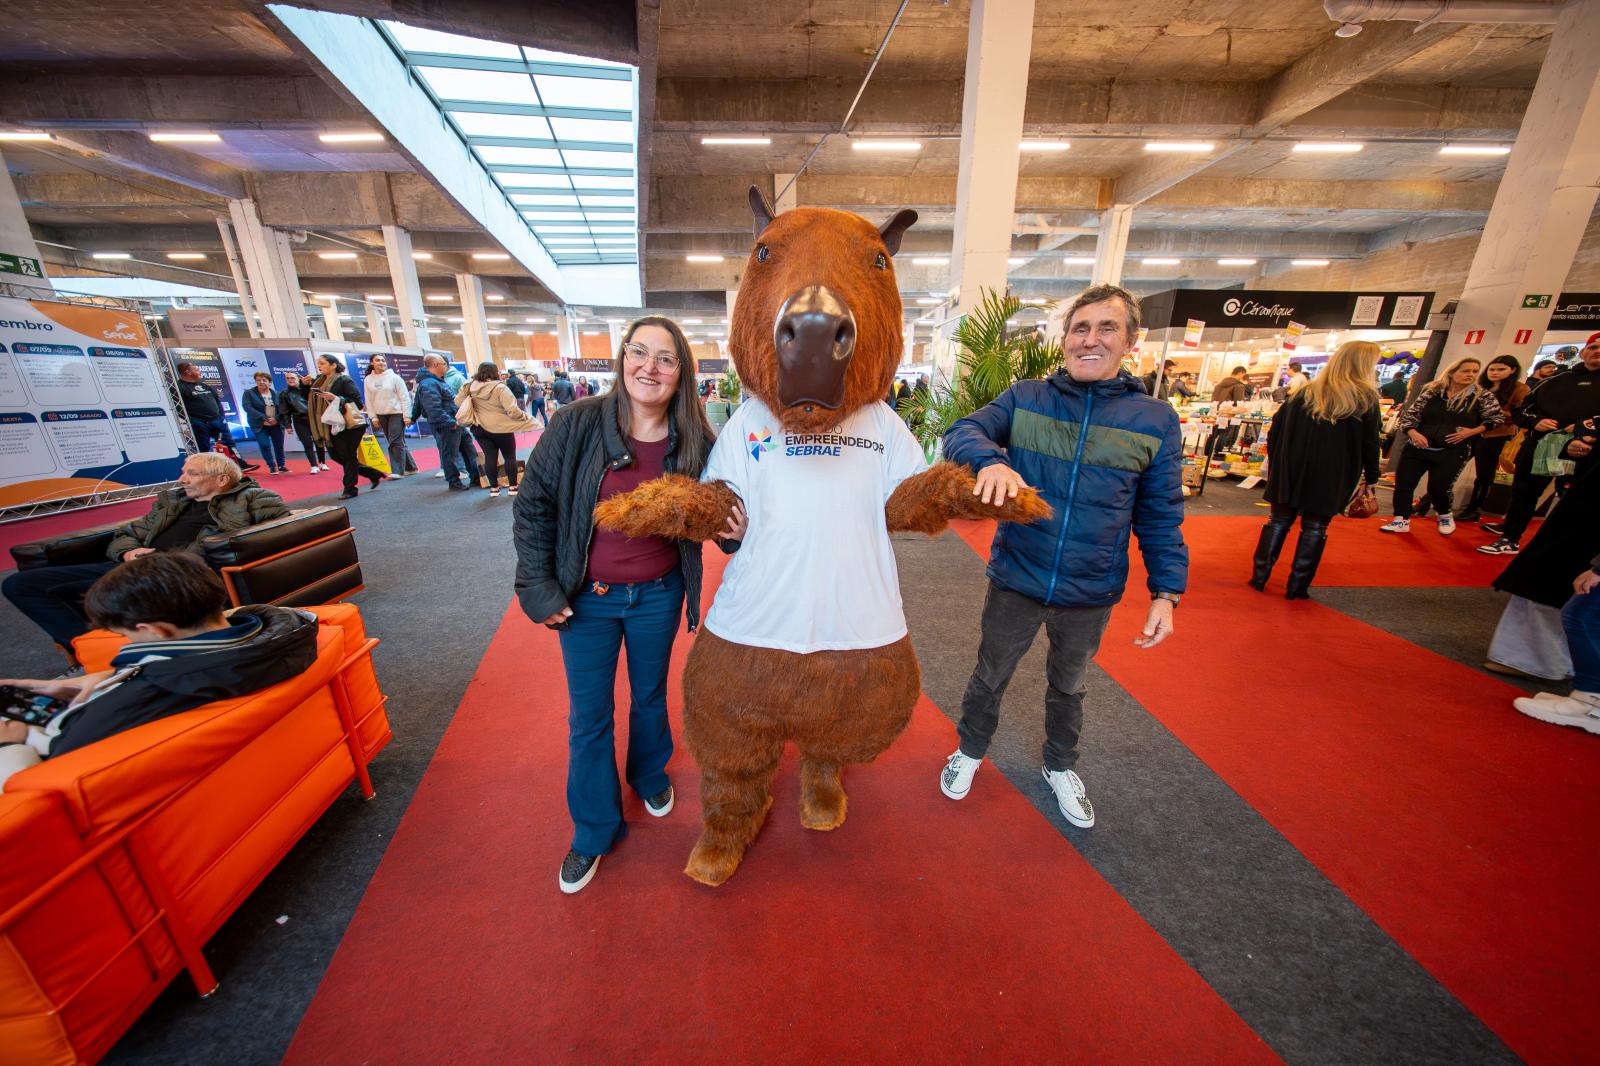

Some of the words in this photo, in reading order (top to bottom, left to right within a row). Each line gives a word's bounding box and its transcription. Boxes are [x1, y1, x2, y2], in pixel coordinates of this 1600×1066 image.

[235, 360, 257, 368] Sesc
[785, 434, 885, 454] EMPREENDEDOR
[785, 445, 841, 456] SEBRAE
